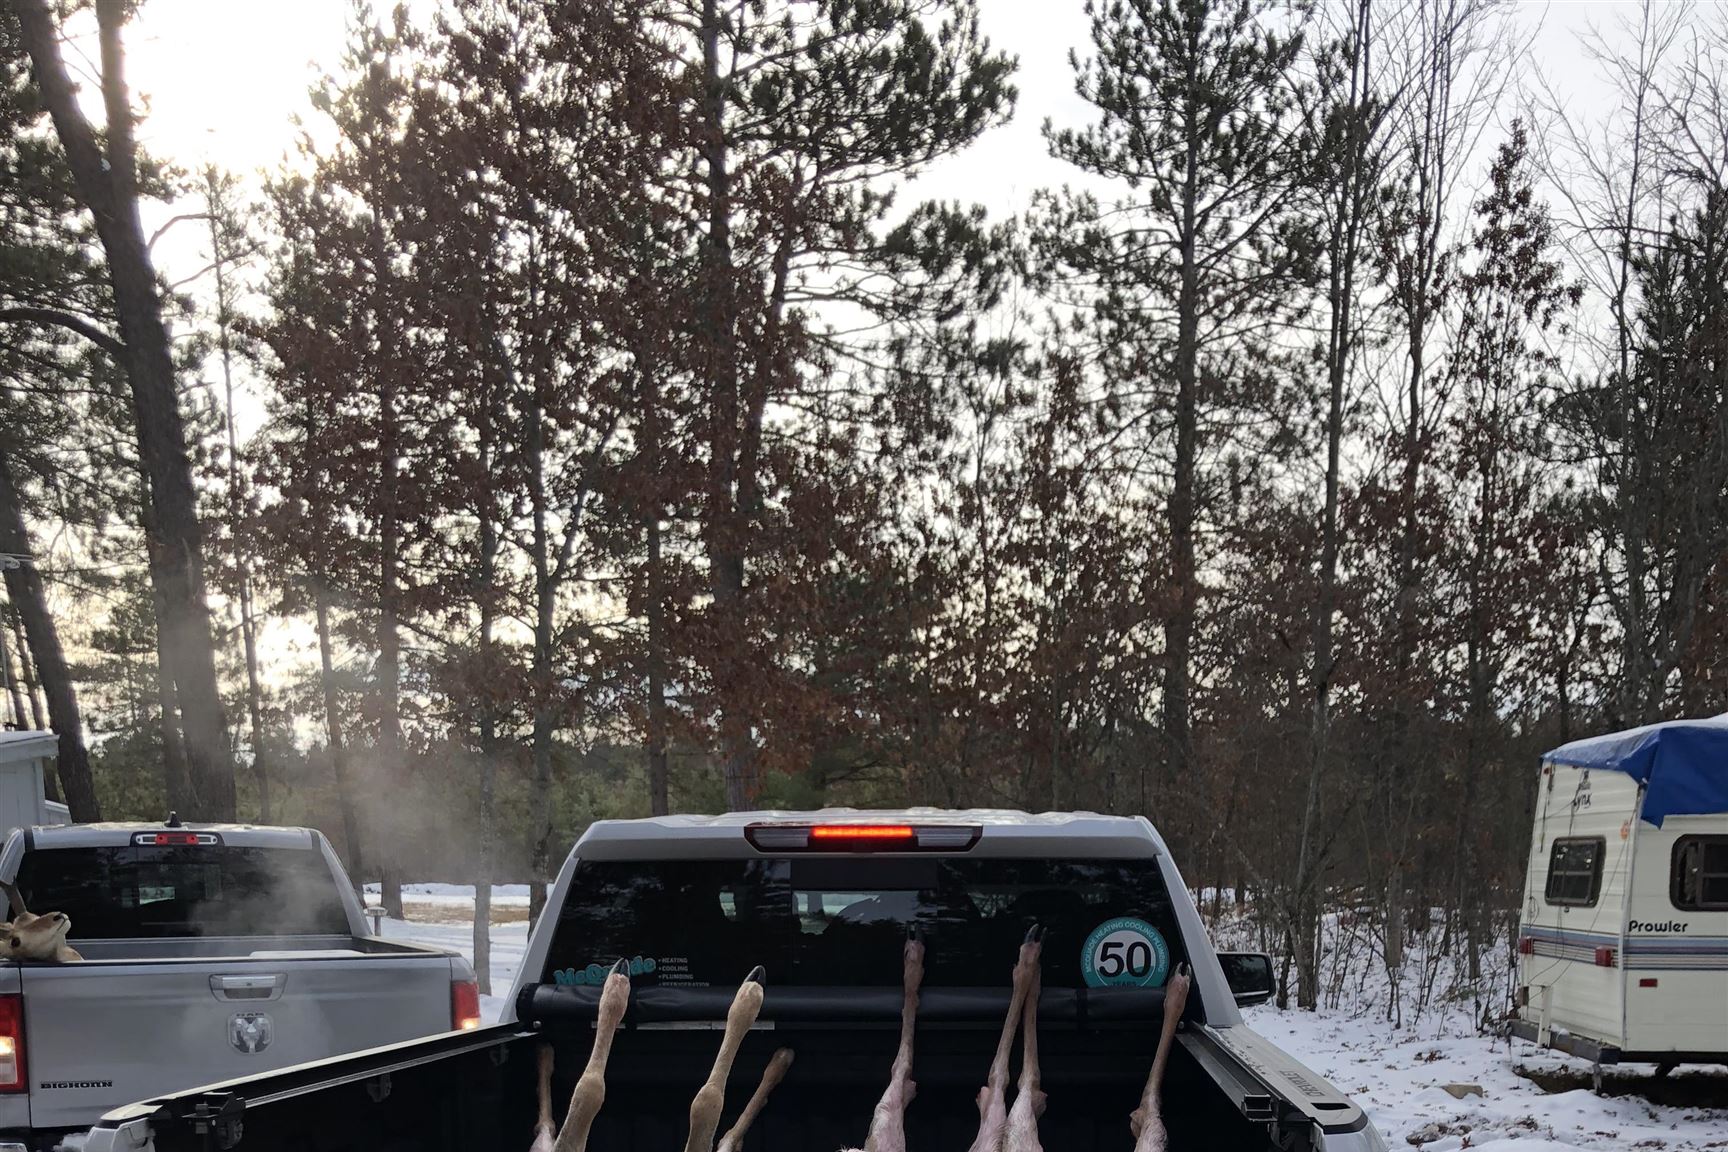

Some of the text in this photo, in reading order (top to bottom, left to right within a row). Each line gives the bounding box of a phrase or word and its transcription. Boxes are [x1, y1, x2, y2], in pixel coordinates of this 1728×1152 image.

[1628, 920, 1688, 932] Prowler
[1095, 921, 1123, 941] HEATING
[1124, 921, 1156, 938] COOLING
[1152, 936, 1166, 973] PLUMBING
[1099, 941, 1152, 978] 50
[40, 1080, 113, 1090] BIGHORN
